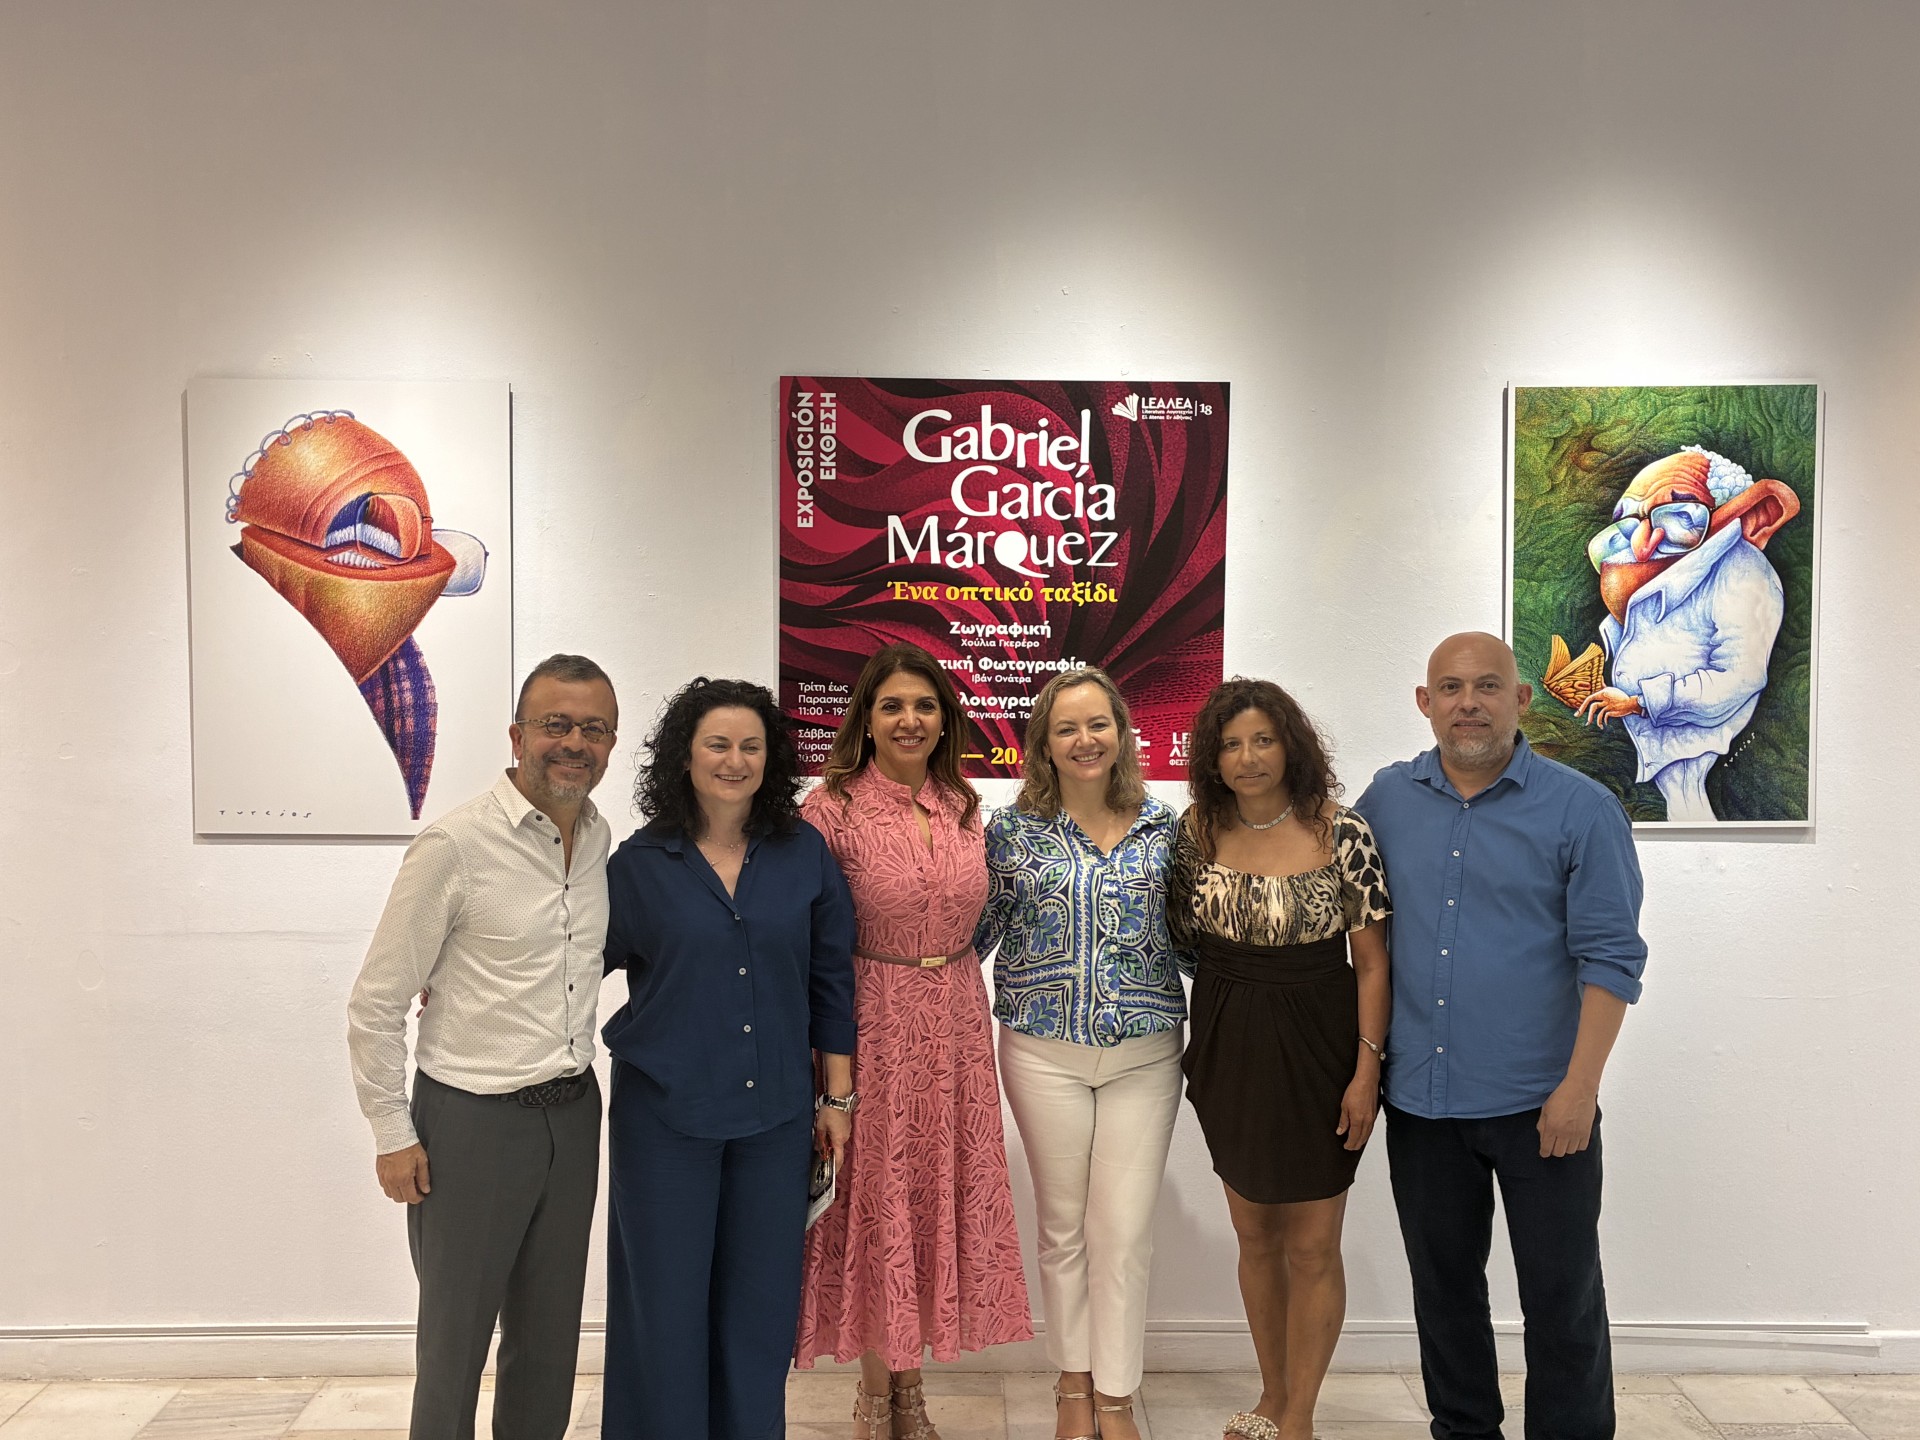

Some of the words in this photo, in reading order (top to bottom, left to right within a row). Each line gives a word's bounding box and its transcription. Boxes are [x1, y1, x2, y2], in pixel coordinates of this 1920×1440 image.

[820, 392, 837, 480] ΕΚΘΕΣΗ
[902, 404, 1091, 471] Gabriel
[797, 391, 814, 528] EXPOSICIÓN
[951, 464, 1116, 521] García
[887, 580, 940, 603] Ένα
[945, 579, 1034, 603] οπτικό
[1039, 580, 1118, 605] ταξίδι
[949, 620, 1052, 638] Ζωγραφική
[961, 638, 997, 648] Χούλια
[998, 638, 1040, 649] Γκερέρο
[978, 655, 1087, 674] Φωτογραφία
[971, 674, 992, 684] Ιβάν
[995, 673, 1032, 684] Ονάτρα
[798, 681, 826, 694] Τρίτη
[828, 682, 849, 693] έως
[798, 694, 853, 706] Παρασκευ
[798, 707, 823, 716] 11:00
[832, 707, 849, 716] 19:
[967, 710, 1017, 720] Φιγκερόα
[798, 728, 838, 740] Σάββατ
[797, 741, 834, 752] Κυριακ
